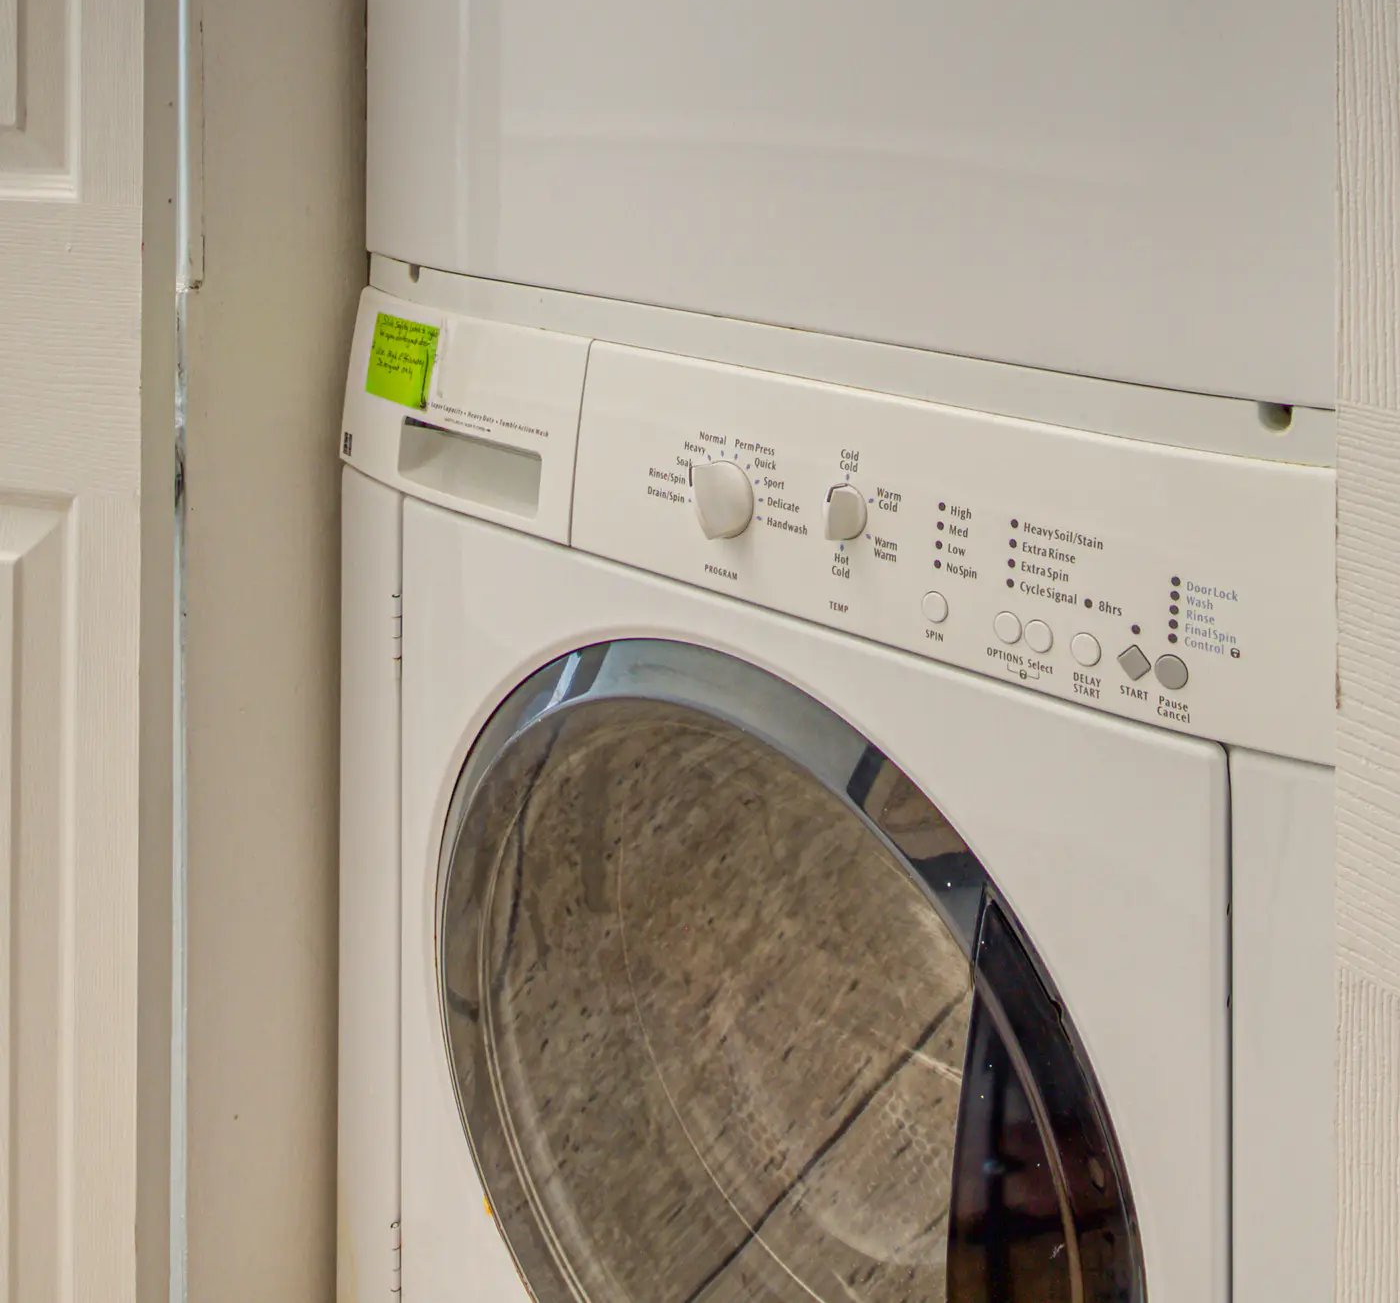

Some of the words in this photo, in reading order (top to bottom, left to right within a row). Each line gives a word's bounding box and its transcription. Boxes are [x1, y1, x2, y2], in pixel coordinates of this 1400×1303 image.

[699, 431, 727, 446] Normal
[684, 441, 706, 456] Heavy
[840, 448, 860, 461] Cold
[754, 457, 777, 471] Quick
[839, 459, 858, 473] Cold
[648, 467, 686, 486] Rinse/Spin
[763, 476, 785, 490] Sport
[647, 485, 685, 504] Drain/Spin
[876, 486, 902, 503] Warm
[767, 497, 800, 513] Delicate
[878, 499, 898, 513] Cold
[950, 505, 972, 521] High
[766, 517, 808, 536] Handwash
[949, 524, 969, 538] Med
[874, 536, 898, 552] Warm
[947, 542, 967, 556] Low
[834, 552, 849, 566] Hot
[873, 547, 897, 563] Warm
[1022, 541, 1047, 557] Extra
[1048, 547, 1077, 564] Rinse
[704, 563, 738, 581] PROGRAM
[831, 565, 850, 579] Cold
[1021, 560, 1046, 577] Extra
[1046, 567, 1070, 582] Spin
[829, 600, 849, 614] TEMP
[1186, 595, 1214, 610] Wash
[1186, 609, 1216, 625] Rinse
[925, 629, 944, 642] SPIN
[1184, 635, 1225, 655] Control
[986, 646, 1024, 666] OPTIONS
[1027, 658, 1053, 675] Select
[1073, 671, 1102, 688] DELAY
[1073, 683, 1101, 699] START
[1119, 684, 1149, 701] START
[1158, 695, 1189, 712] Pause
[1156, 706, 1191, 724] Cancel
